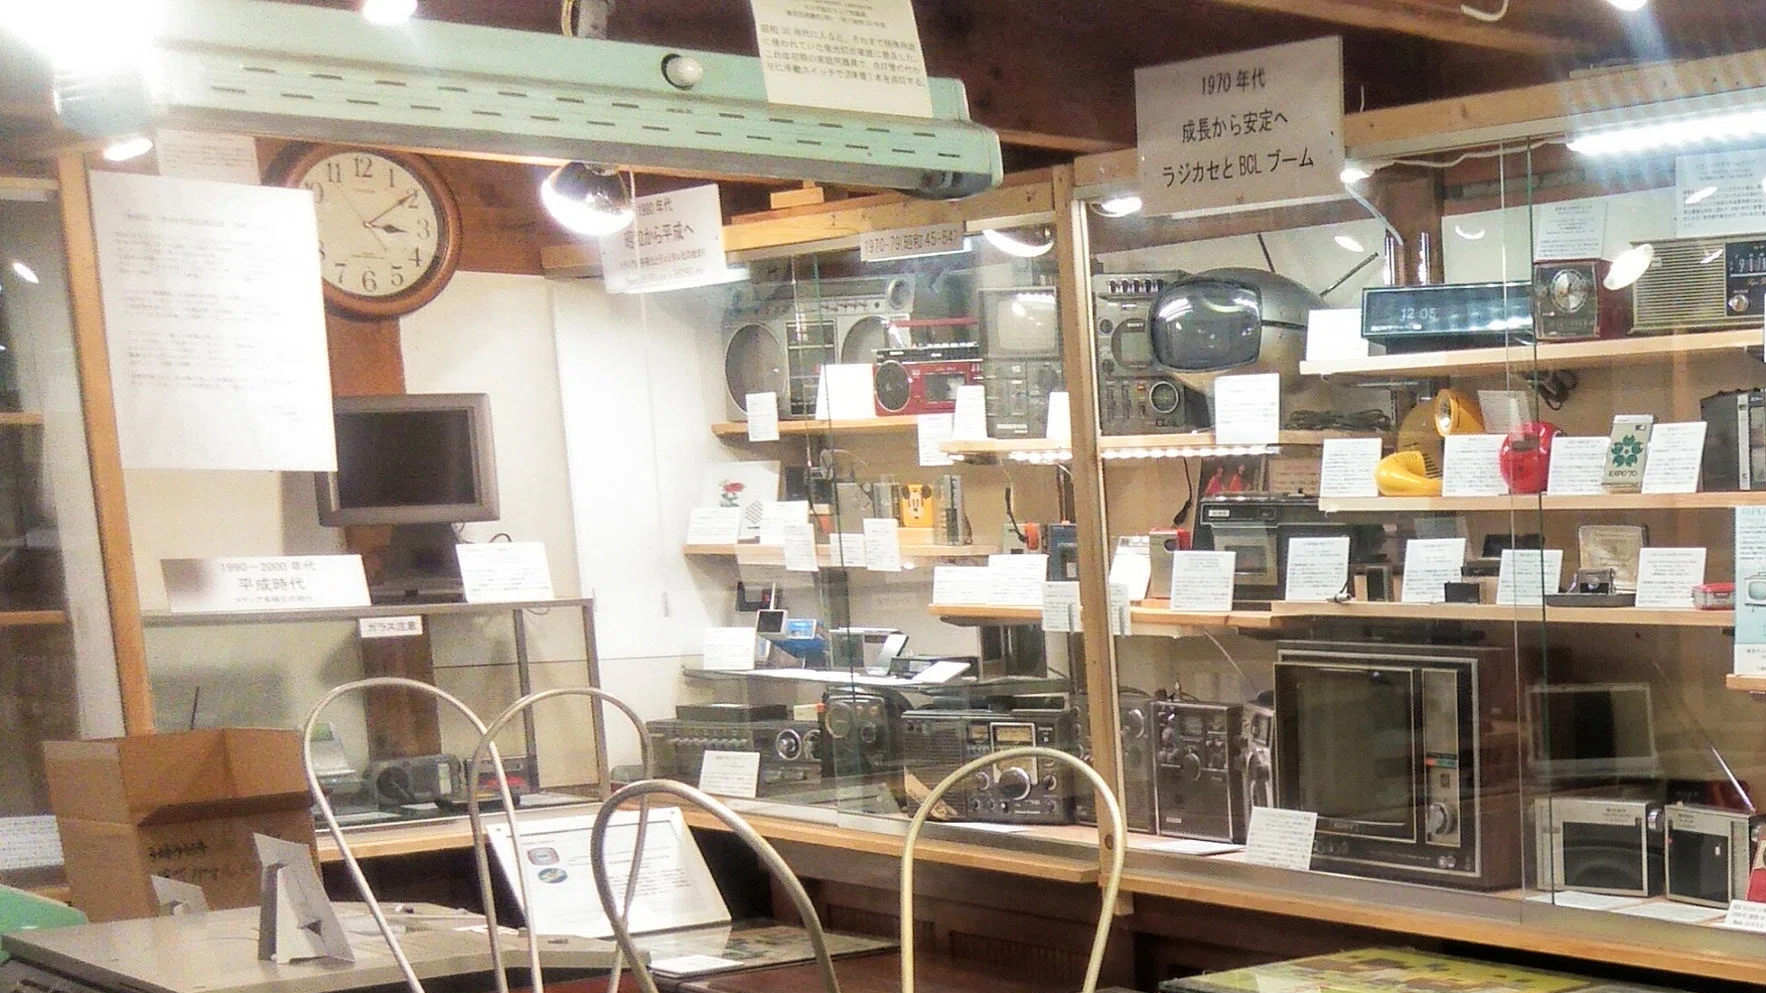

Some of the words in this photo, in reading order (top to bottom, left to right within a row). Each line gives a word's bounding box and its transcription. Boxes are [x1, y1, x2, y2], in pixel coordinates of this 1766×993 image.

[1202, 72, 1231, 95] 1970
[1236, 67, 1265, 92] 年代
[1182, 108, 1288, 143] 成長から安定へ
[327, 162, 341, 183] 11
[354, 157, 373, 178] 12
[389, 167, 395, 188] 1
[1163, 158, 1233, 187] ラジカセと
[1239, 154, 1261, 176] BCL
[1267, 147, 1313, 171] ブーム
[406, 188, 420, 209] 2
[417, 219, 430, 240] 3
[408, 247, 422, 267] 4
[334, 263, 347, 284] 7
[362, 270, 377, 292] 6
[391, 264, 404, 286] 5
[238, 577, 305, 592] 平成時代
[367, 621, 418, 632] ガラス注意
